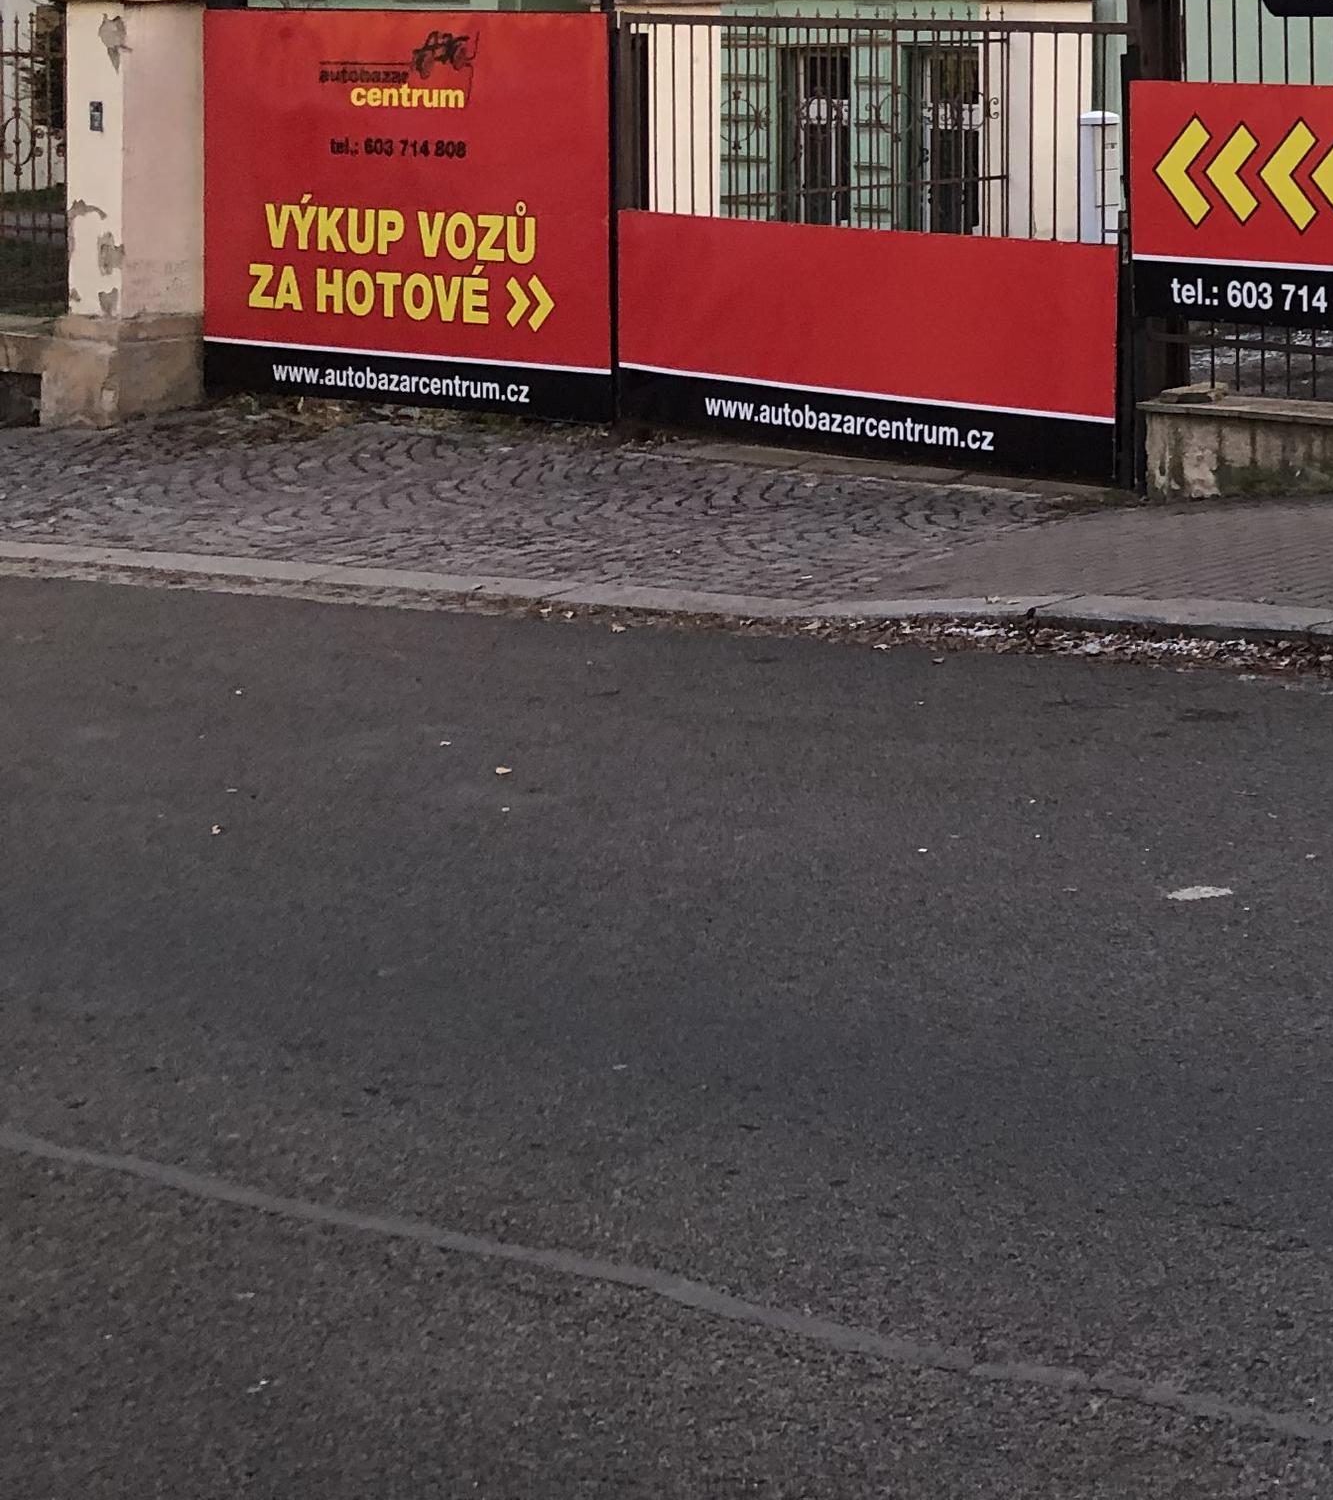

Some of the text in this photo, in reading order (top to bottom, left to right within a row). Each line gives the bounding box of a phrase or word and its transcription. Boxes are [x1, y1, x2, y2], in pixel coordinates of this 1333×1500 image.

[319, 67, 408, 84] autobazar
[351, 82, 464, 108] centrum
[330, 138, 466, 159] tel.: 603 714 808
[264, 194, 536, 264] VÝKUP VOZŮ
[248, 264, 489, 324] ZA HOTOVÉ
[1171, 277, 1219, 306] tel.:
[1226, 280, 1273, 310] 603
[1281, 283, 1328, 314] 714
[272, 363, 530, 403] www.autobazarcentrum.cz
[704, 397, 994, 451] www.autobazarcentrum.cz
